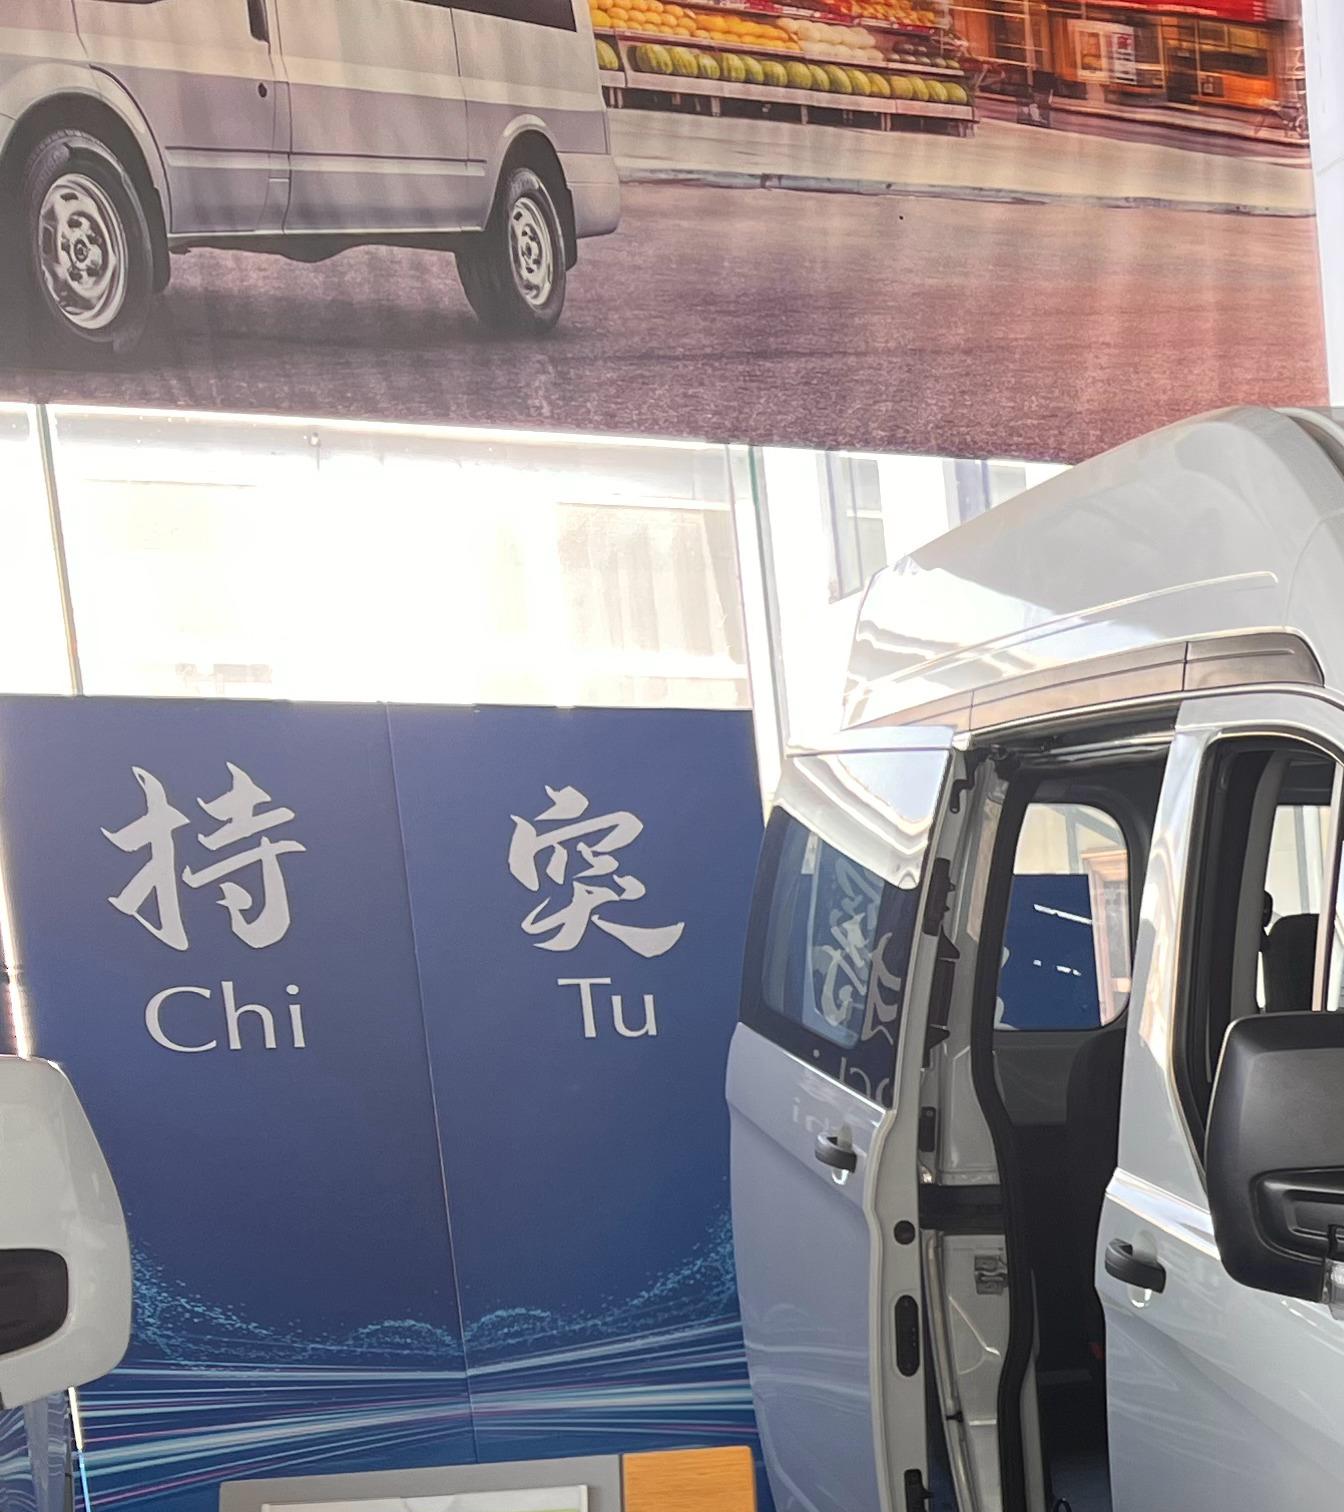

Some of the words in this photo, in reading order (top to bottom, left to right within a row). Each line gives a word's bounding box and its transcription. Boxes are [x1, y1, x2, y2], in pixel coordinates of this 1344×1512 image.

[101, 762, 306, 951] 持
[508, 785, 685, 957] 突
[144, 981, 306, 1053] Chi
[557, 976, 658, 1038] Tu
